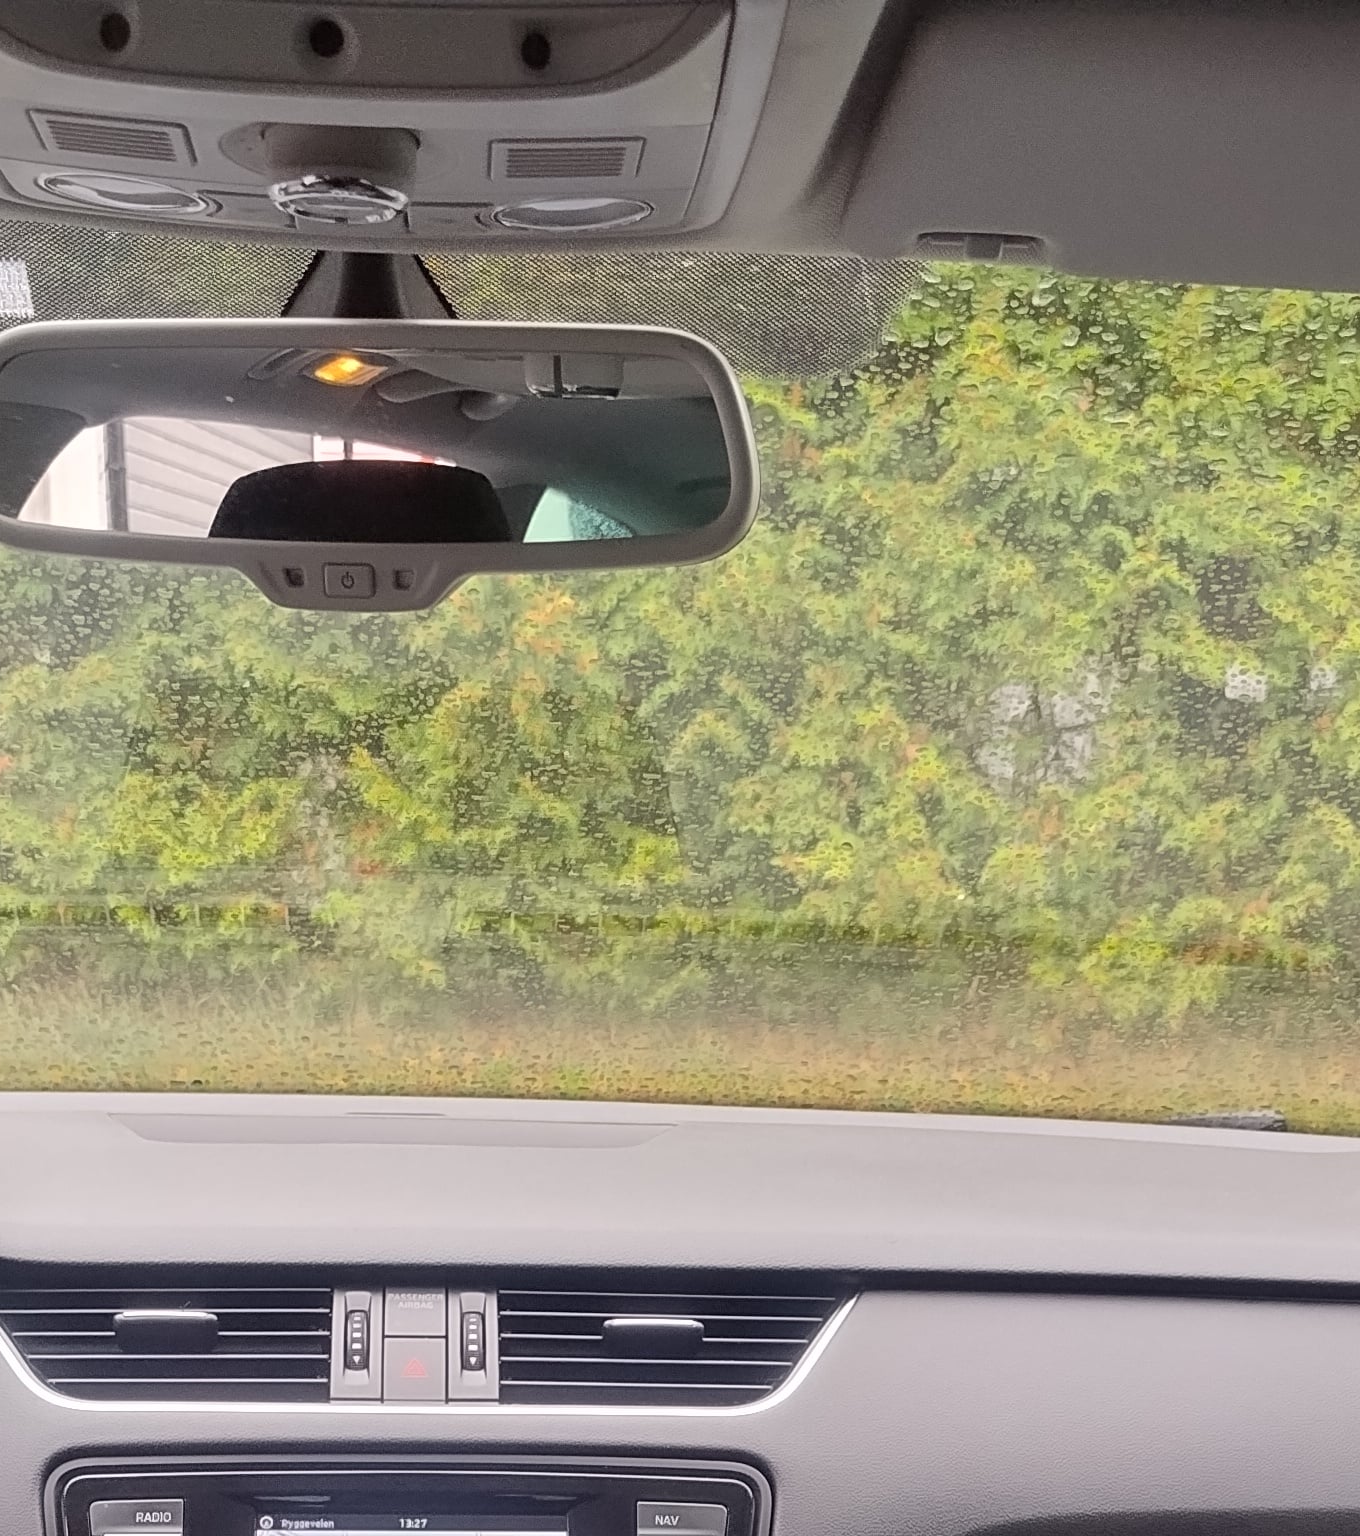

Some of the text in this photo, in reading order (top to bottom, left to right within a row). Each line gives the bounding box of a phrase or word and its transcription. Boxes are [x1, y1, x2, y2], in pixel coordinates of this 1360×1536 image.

[387, 1293, 443, 1301] PASSENGER
[399, 1301, 434, 1309] AIRBAG
[135, 1511, 172, 1523] RADIO
[655, 1514, 680, 1526] NAV
[399, 1518, 428, 1529] 13:27
